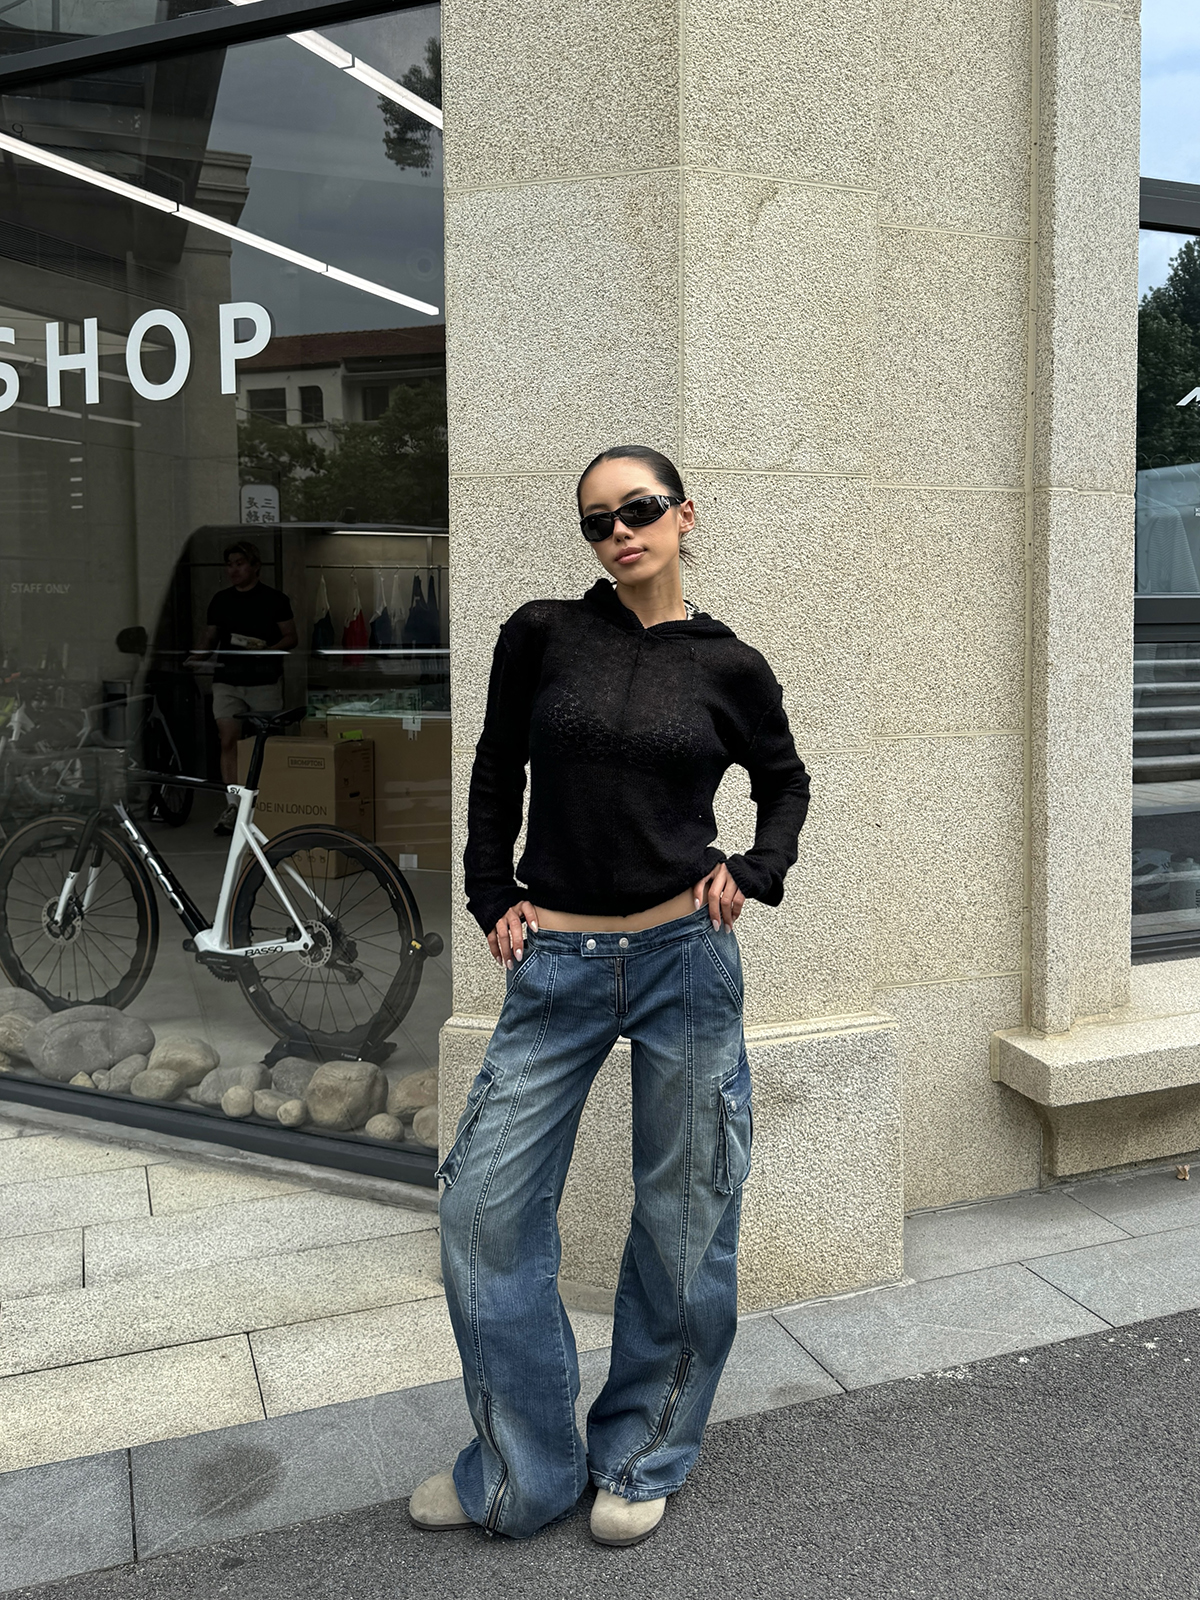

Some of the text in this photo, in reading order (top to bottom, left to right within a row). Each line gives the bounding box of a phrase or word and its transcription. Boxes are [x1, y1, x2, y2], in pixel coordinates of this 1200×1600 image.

[11, 582, 71, 595] STAFF ONLY
[290, 758, 323, 767] BROMPTON
[256, 802, 327, 816] ADE IN LONDON
[245, 945, 284, 957] BASSO
